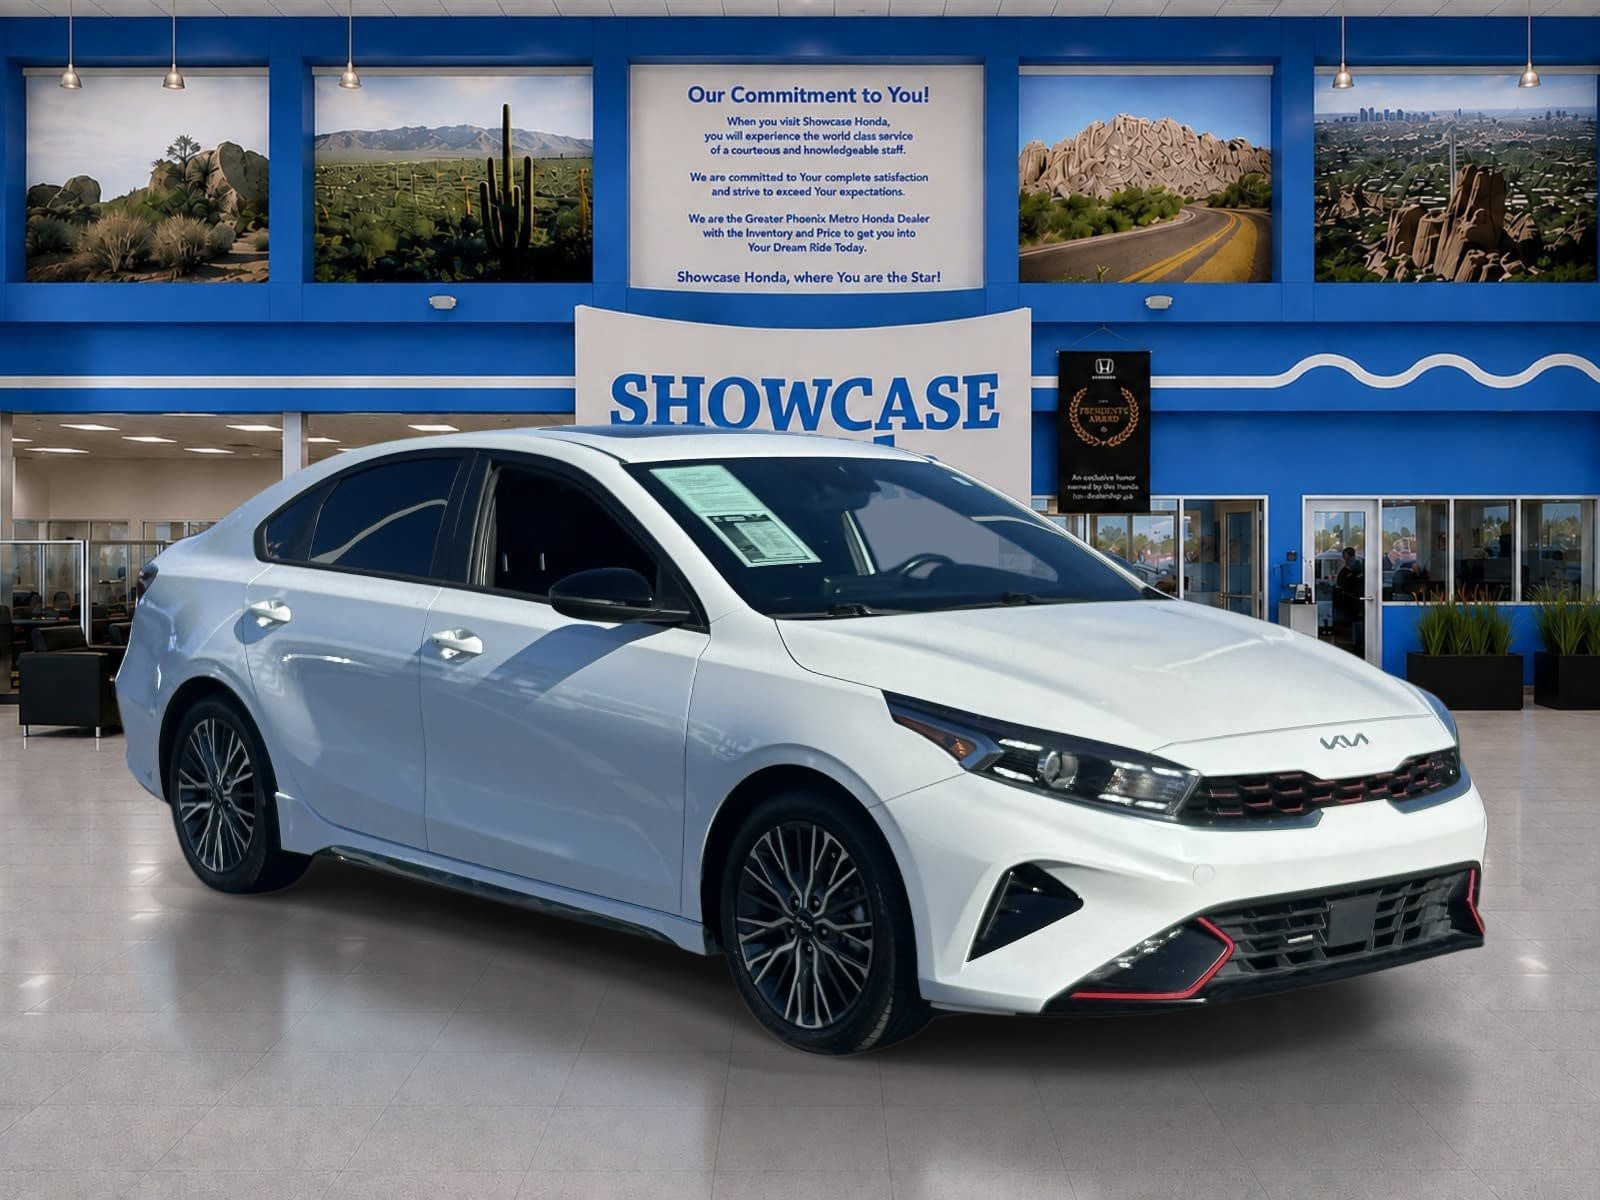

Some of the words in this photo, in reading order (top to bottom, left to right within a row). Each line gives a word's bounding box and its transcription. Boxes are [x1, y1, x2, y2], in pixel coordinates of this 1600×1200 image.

[687, 85, 727, 104] Our
[730, 85, 858, 104] Commitment
[860, 87, 883, 104] to
[886, 85, 930, 104] You!
[726, 116, 757, 127] When
[758, 118, 778, 129] you
[779, 116, 801, 127] visit
[802, 115, 853, 127] Showcase
[854, 116, 891, 129] Honda,
[704, 133, 724, 144] you
[725, 130, 744, 141] will
[744, 130, 801, 144] experience
[802, 130, 821, 141] the
[821, 130, 852, 142] world
[852, 130, 877, 142] class
[878, 130, 914, 142] service
[709, 144, 721, 155] of
[722, 146, 730, 155] a
[730, 145, 782, 155] courteous
[782, 144, 802, 155] and
[881, 144, 907, 155] staff.
[689, 171, 708, 183] We
[709, 174, 727, 182] are
[728, 171, 784, 183] committed
[785, 173, 798, 183] to
[799, 172, 823, 183] Your
[824, 171, 872, 185] complete
[873, 171, 929, 183] satisfaction
[711, 185, 731, 197] and
[732, 186, 761, 197] strive
[762, 187, 774, 197] to
[775, 186, 812, 197] exceed
[813, 186, 838, 197] Your
[838, 186, 906, 200] expectations.
[688, 213, 706, 224] We
[707, 215, 725, 224] are
[725, 213, 743, 224] the
[744, 213, 785, 224] Greater
[785, 213, 827, 224] Phoenix
[828, 213, 860, 224] Metro
[861, 213, 895, 224] Honda
[897, 213, 931, 224] Dealer
[702, 227, 725, 238] with
[726, 227, 744, 239] the
[745, 227, 794, 241] Inventory
[794, 227, 815, 239] and
[816, 227, 842, 239] Price
[843, 229, 855, 238] to
[856, 228, 875, 241] get
[875, 230, 895, 241] you
[896, 227, 917, 239] into
[747, 242, 772, 253] Your
[773, 242, 808, 253] Dream
[809, 242, 833, 253] Ride
[833, 242, 868, 255] Today.
[676, 270, 741, 284] Showcase
[744, 270, 791, 286] Honda,
[793, 270, 834, 284] where
[836, 271, 861, 284] You
[863, 273, 884, 284] are
[886, 270, 908, 284] the
[910, 270, 941, 284] Star!
[610, 372, 1001, 431] SHOWCASE
